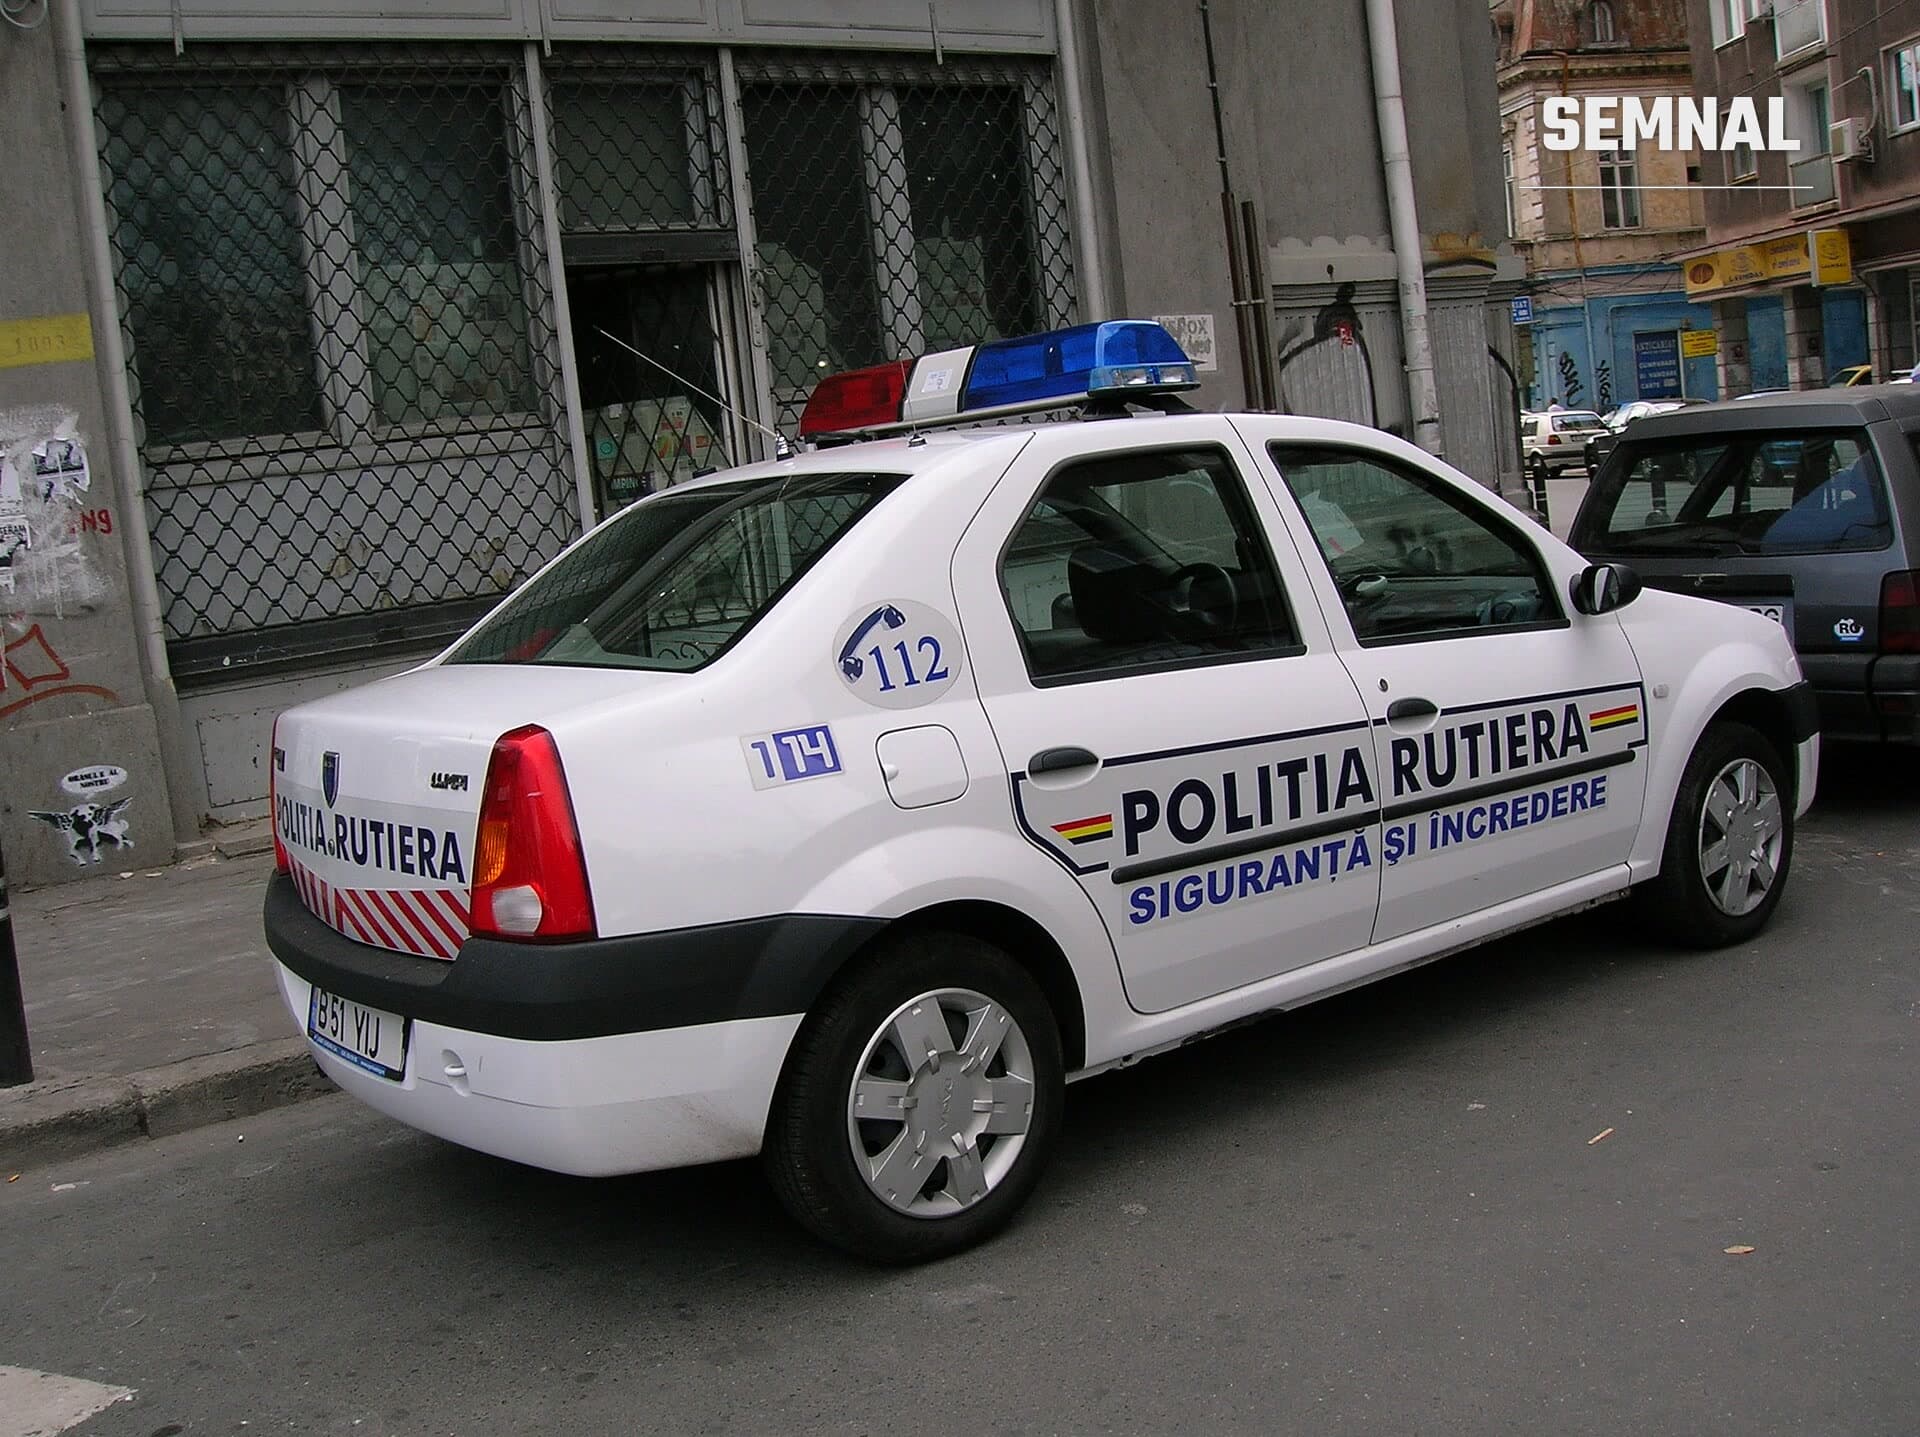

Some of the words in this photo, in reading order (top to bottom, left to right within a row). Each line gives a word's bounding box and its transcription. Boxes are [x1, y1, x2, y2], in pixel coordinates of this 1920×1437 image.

[868, 635, 949, 692] 112
[1121, 747, 1375, 857] POLITIA
[1391, 702, 1589, 797] RUTIERA
[1429, 775, 1608, 851] ÎNCREDERE
[276, 793, 328, 856] POLITIA
[334, 813, 467, 884] RUTIERA
[354, 1006, 380, 1059] YIJ
